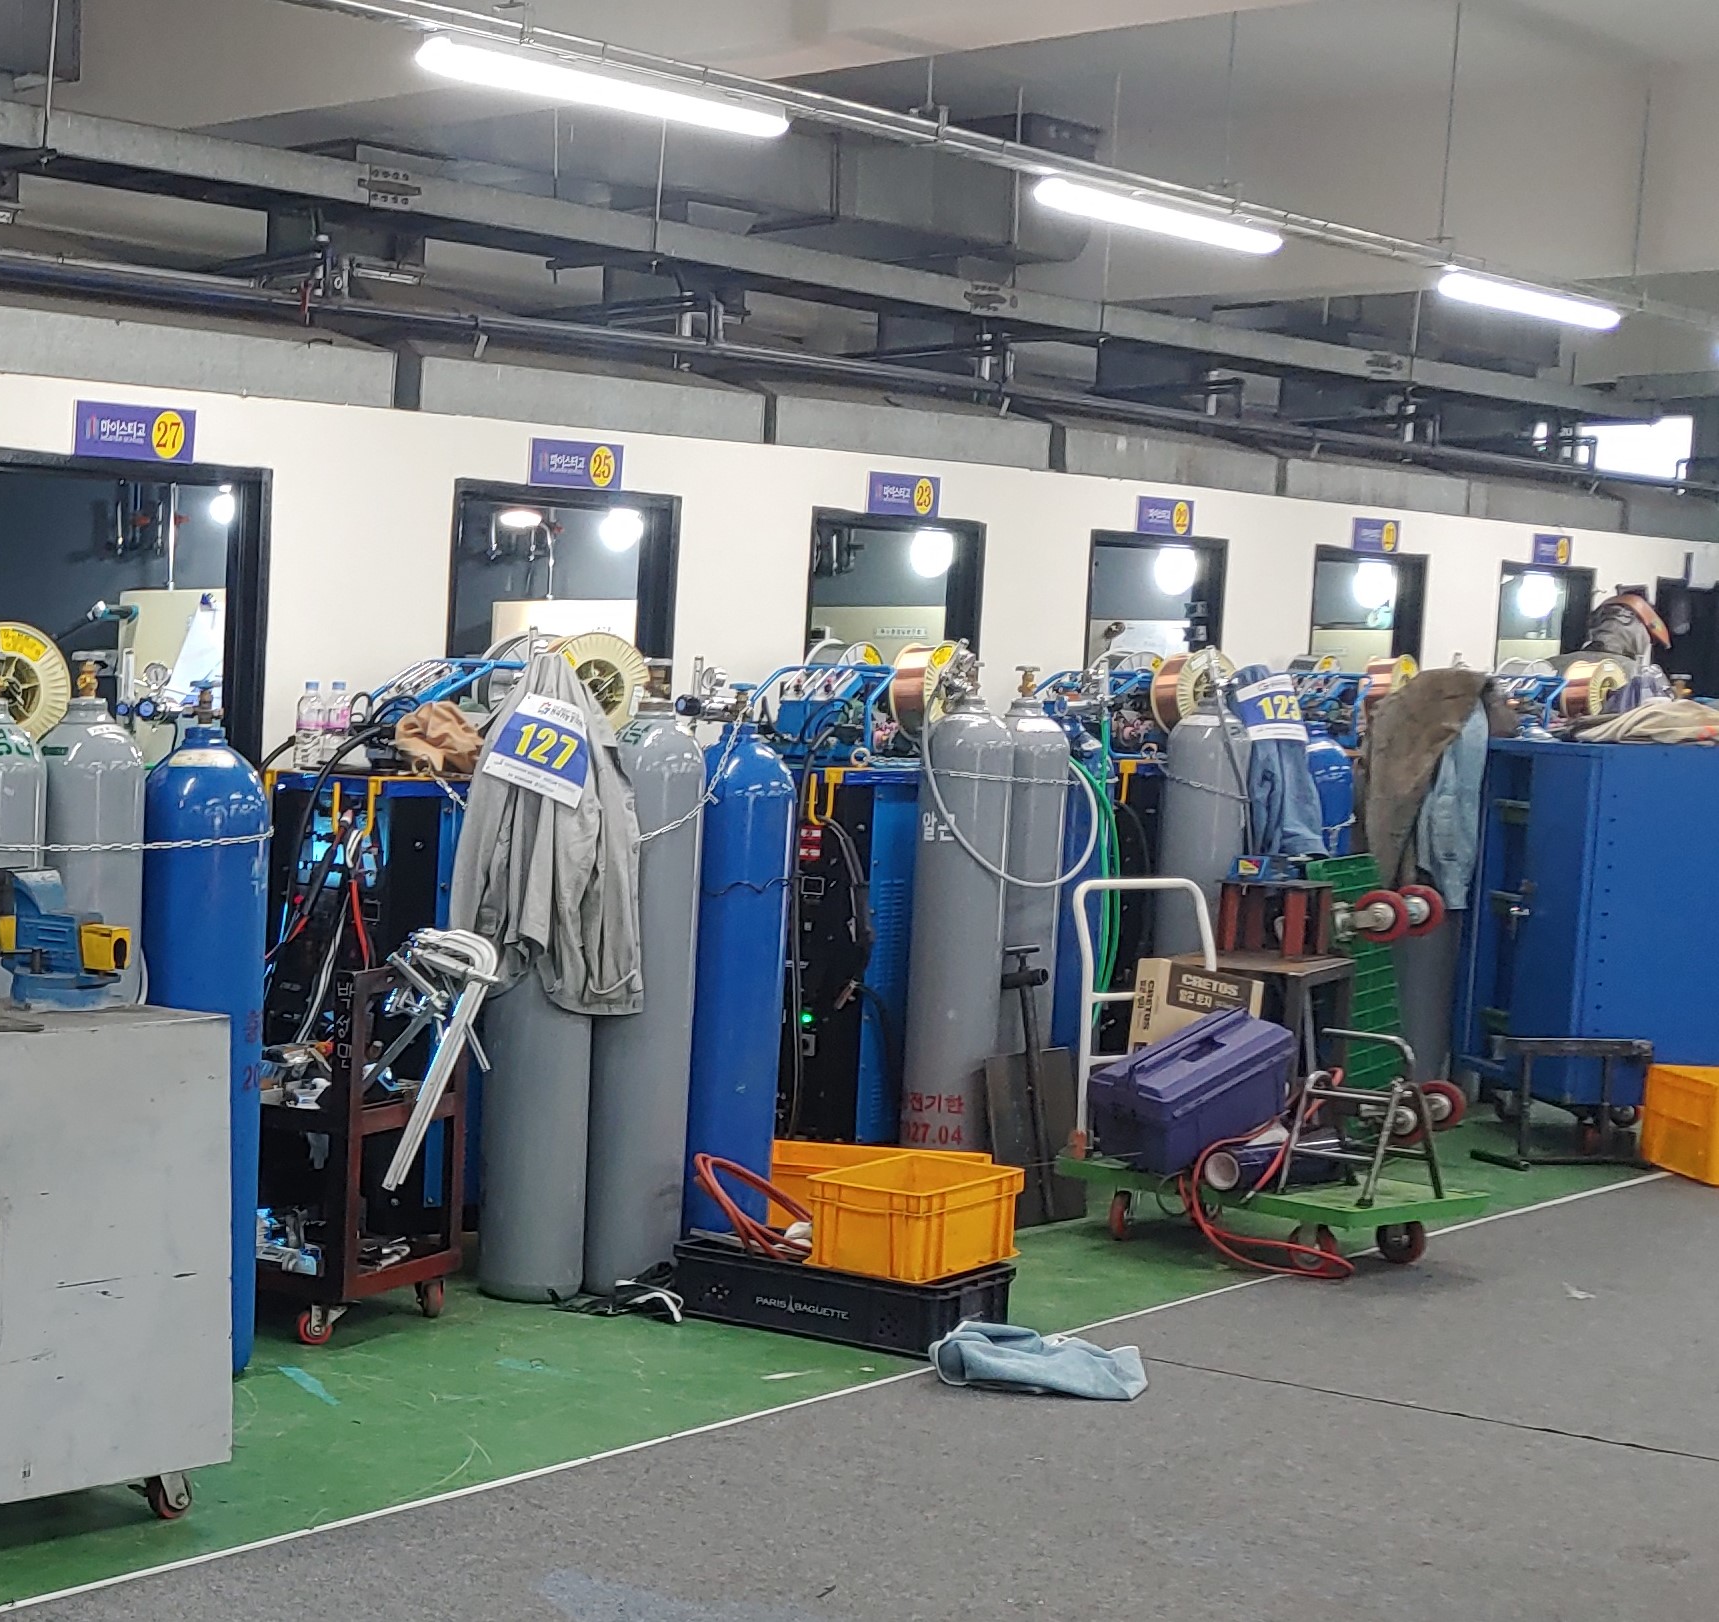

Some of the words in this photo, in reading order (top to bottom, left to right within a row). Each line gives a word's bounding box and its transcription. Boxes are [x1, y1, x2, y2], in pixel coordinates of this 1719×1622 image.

[100, 418, 146, 438] 마이스터고
[156, 421, 181, 449] 27
[593, 453, 612, 479] 25
[916, 485, 932, 508] 23
[1256, 694, 1301, 721] 123
[514, 722, 579, 771] 127
[1181, 973, 1240, 997] CRETOS
[1143, 980, 1155, 1031] CRETOS
[904, 1092, 964, 1114] 전기한
[755, 1296, 787, 1309] PARIS
[794, 1302, 849, 1320] BAGUETTE
